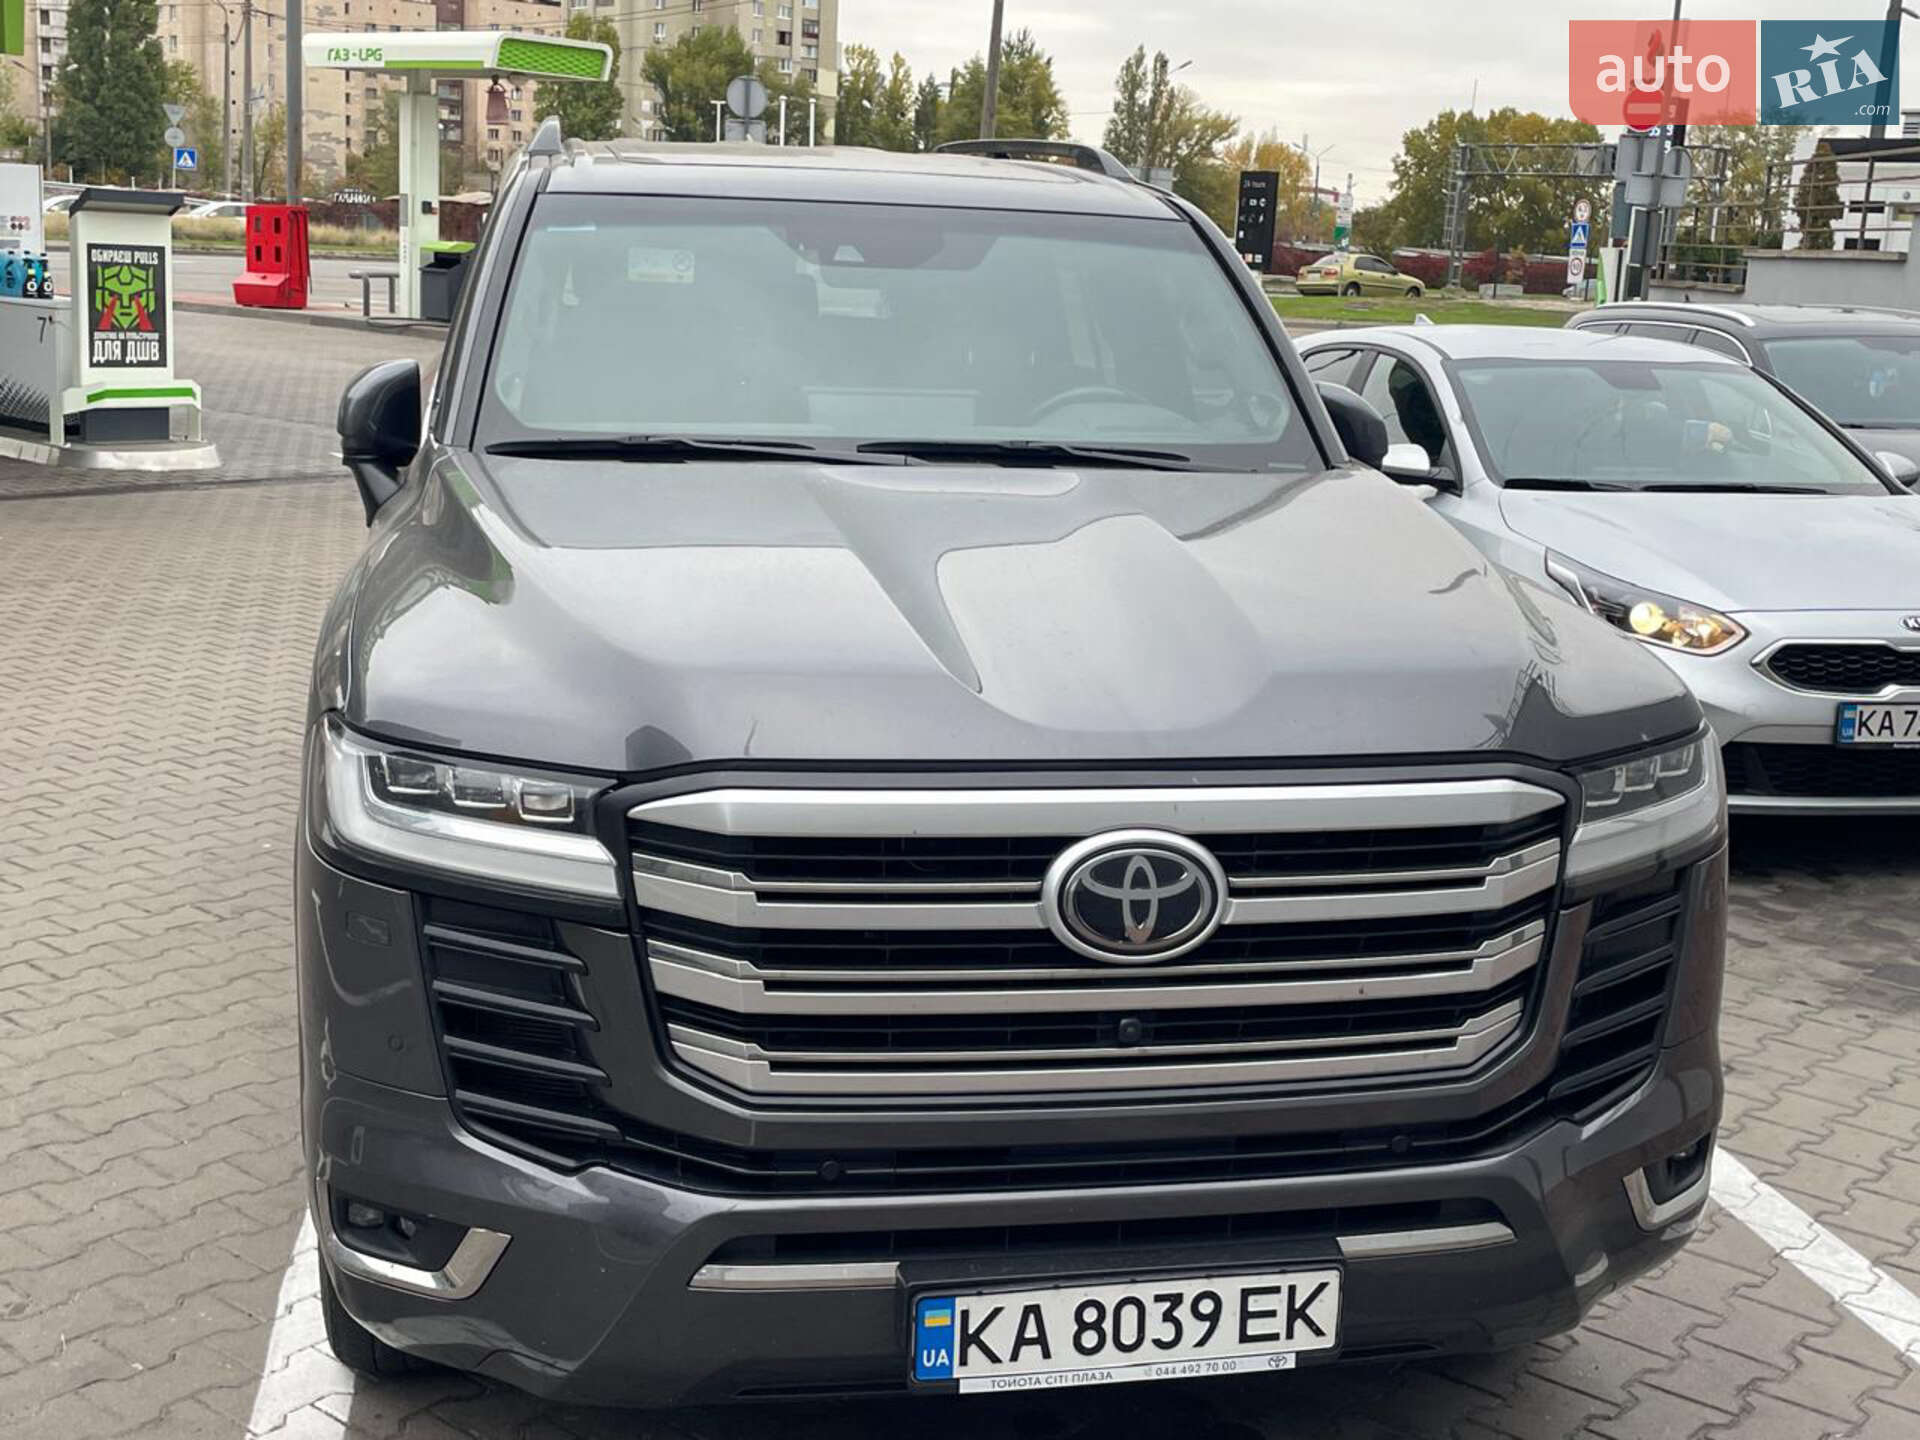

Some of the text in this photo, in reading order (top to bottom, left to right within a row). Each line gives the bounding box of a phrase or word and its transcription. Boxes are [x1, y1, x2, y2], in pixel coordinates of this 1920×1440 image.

[37, 316, 47, 344] 7
[92, 341, 160, 364] ДЛЯ ДШВ
[1857, 710, 1920, 737] KA 7
[958, 1281, 1330, 1367] KA 8039 EK
[922, 1348, 949, 1368] UA
[1155, 1360, 1238, 1377] 044 492 70 00
[1072, 1370, 1113, 1384] ПЛАЗА
